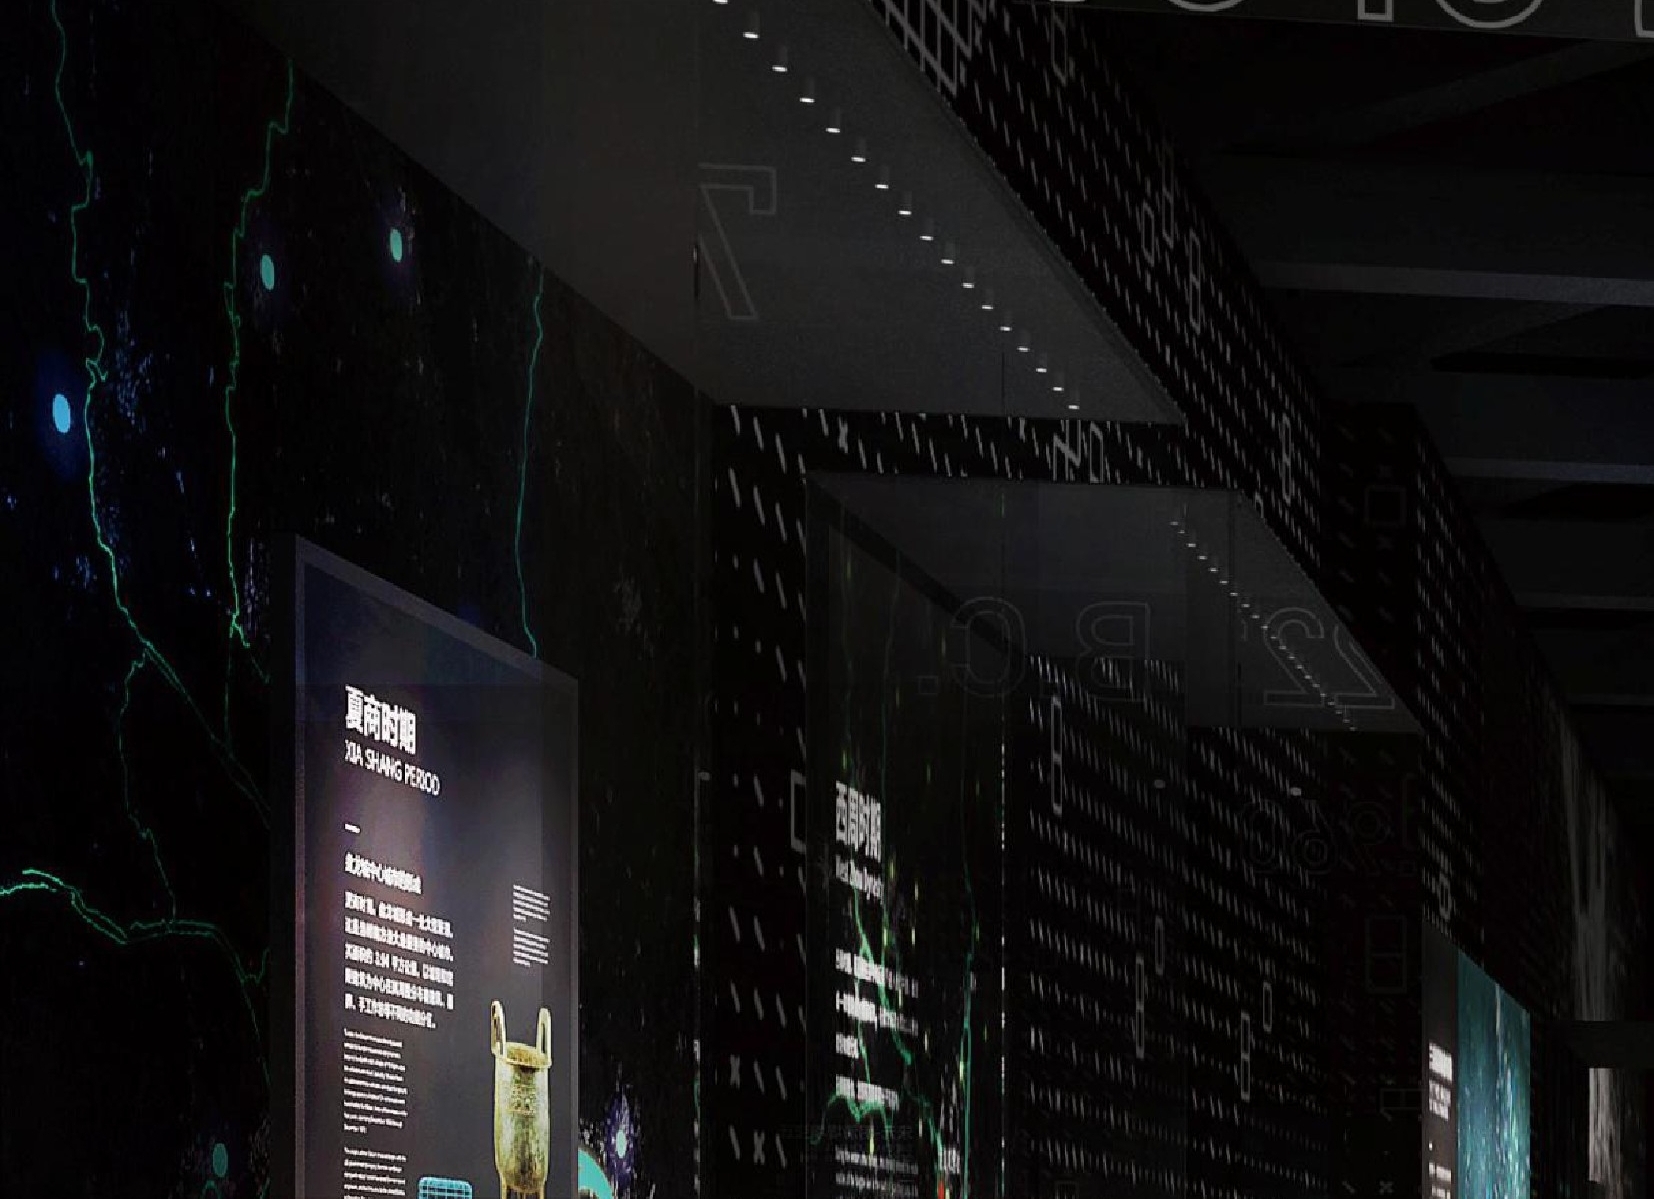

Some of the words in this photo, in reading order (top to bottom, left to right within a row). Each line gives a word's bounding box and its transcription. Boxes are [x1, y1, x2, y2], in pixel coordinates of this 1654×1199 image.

[345, 684, 417, 755] 夏商时期
[365, 747, 402, 782] SHANG
[404, 763, 441, 796] PERIOD
